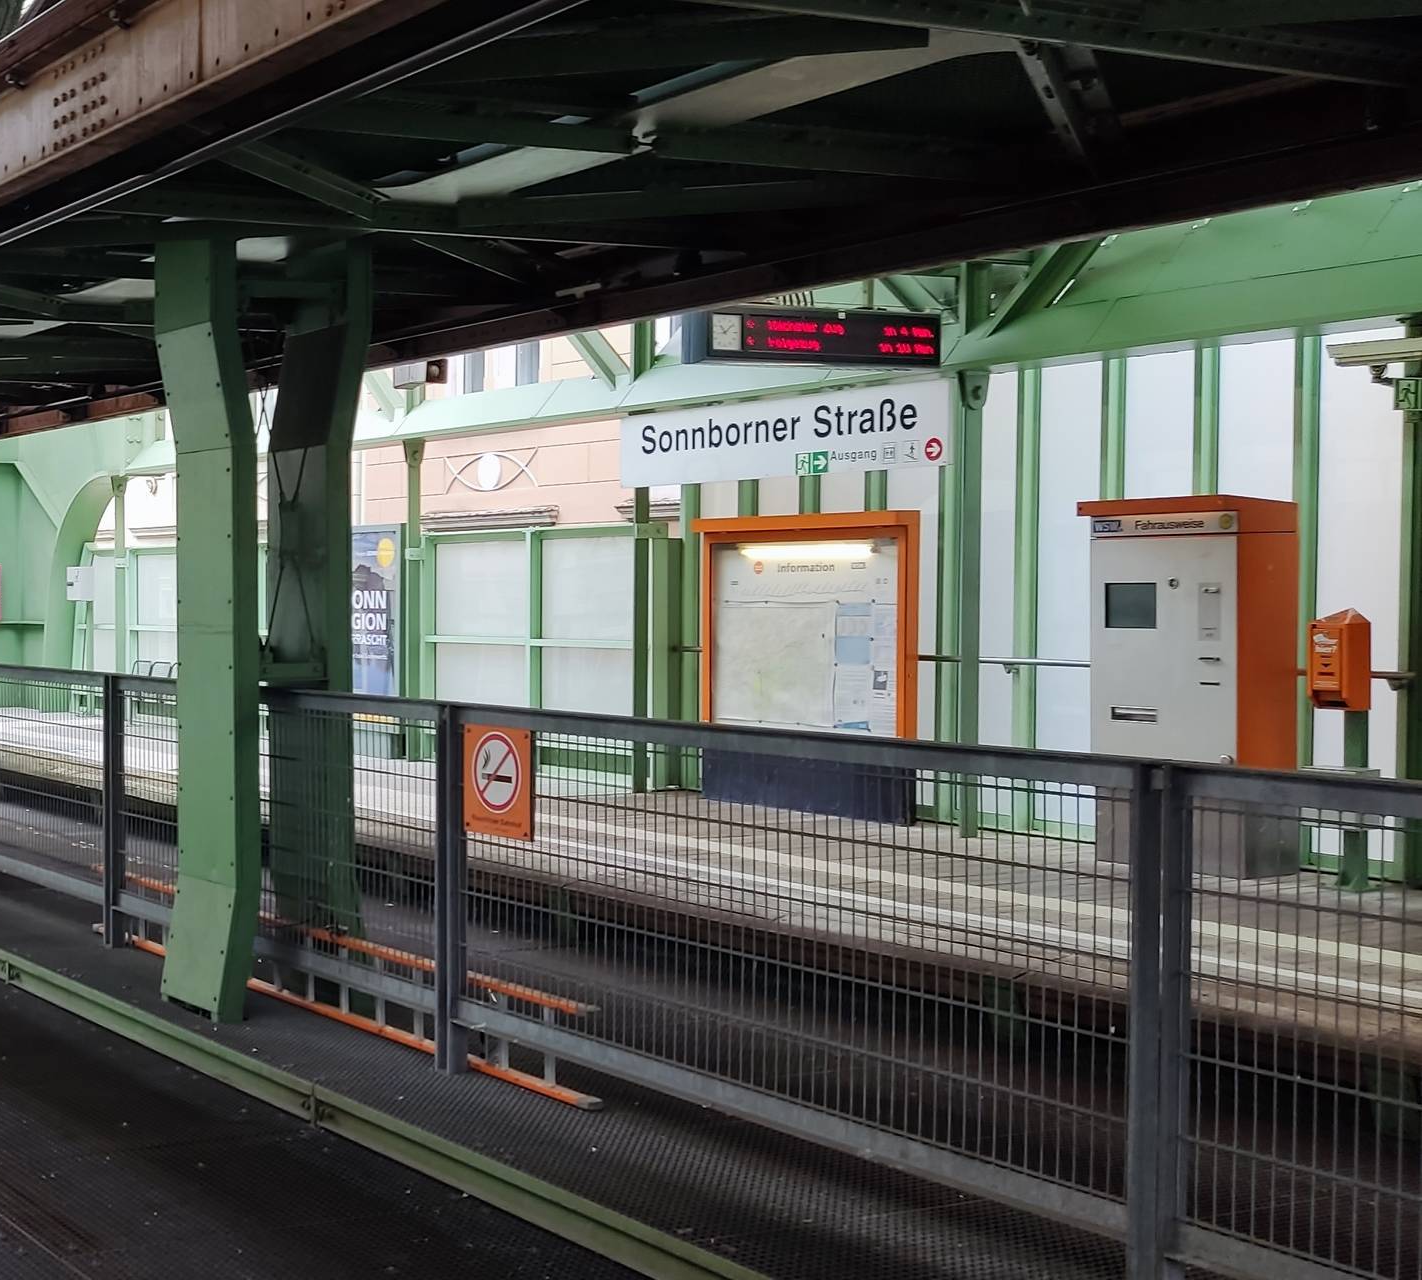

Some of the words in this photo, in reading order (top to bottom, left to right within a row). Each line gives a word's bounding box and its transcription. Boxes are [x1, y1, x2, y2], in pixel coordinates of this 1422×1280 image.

[641, 415, 801, 455] Sonnborner
[813, 398, 918, 438] Straße
[830, 449, 878, 463] Ausgang
[1134, 518, 1205, 531] Fahrausweise
[777, 561, 835, 573] Information
[352, 590, 387, 610] ONN
[352, 612, 387, 631] GION
